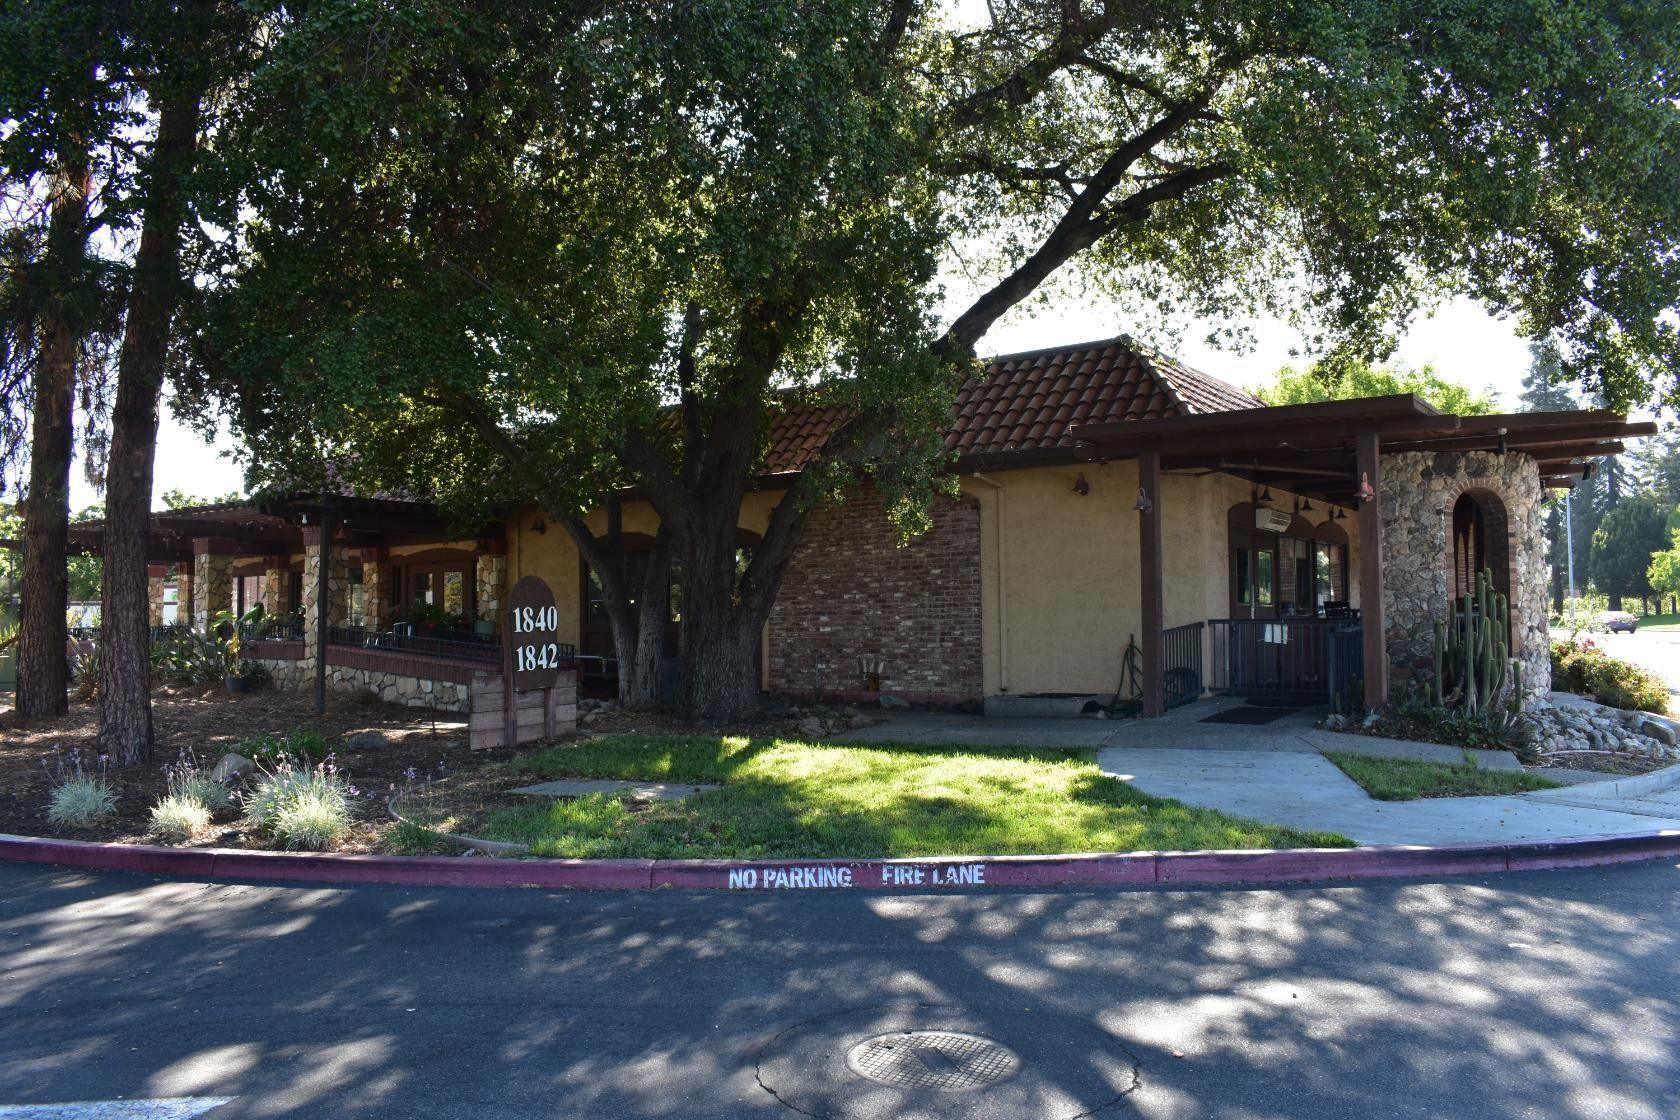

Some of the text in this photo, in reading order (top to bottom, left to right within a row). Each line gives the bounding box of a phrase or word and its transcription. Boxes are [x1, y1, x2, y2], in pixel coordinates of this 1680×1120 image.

[513, 606, 558, 633] 1840
[515, 643, 558, 672] 1842
[729, 864, 985, 889] NO PARKING FIRE LANE
